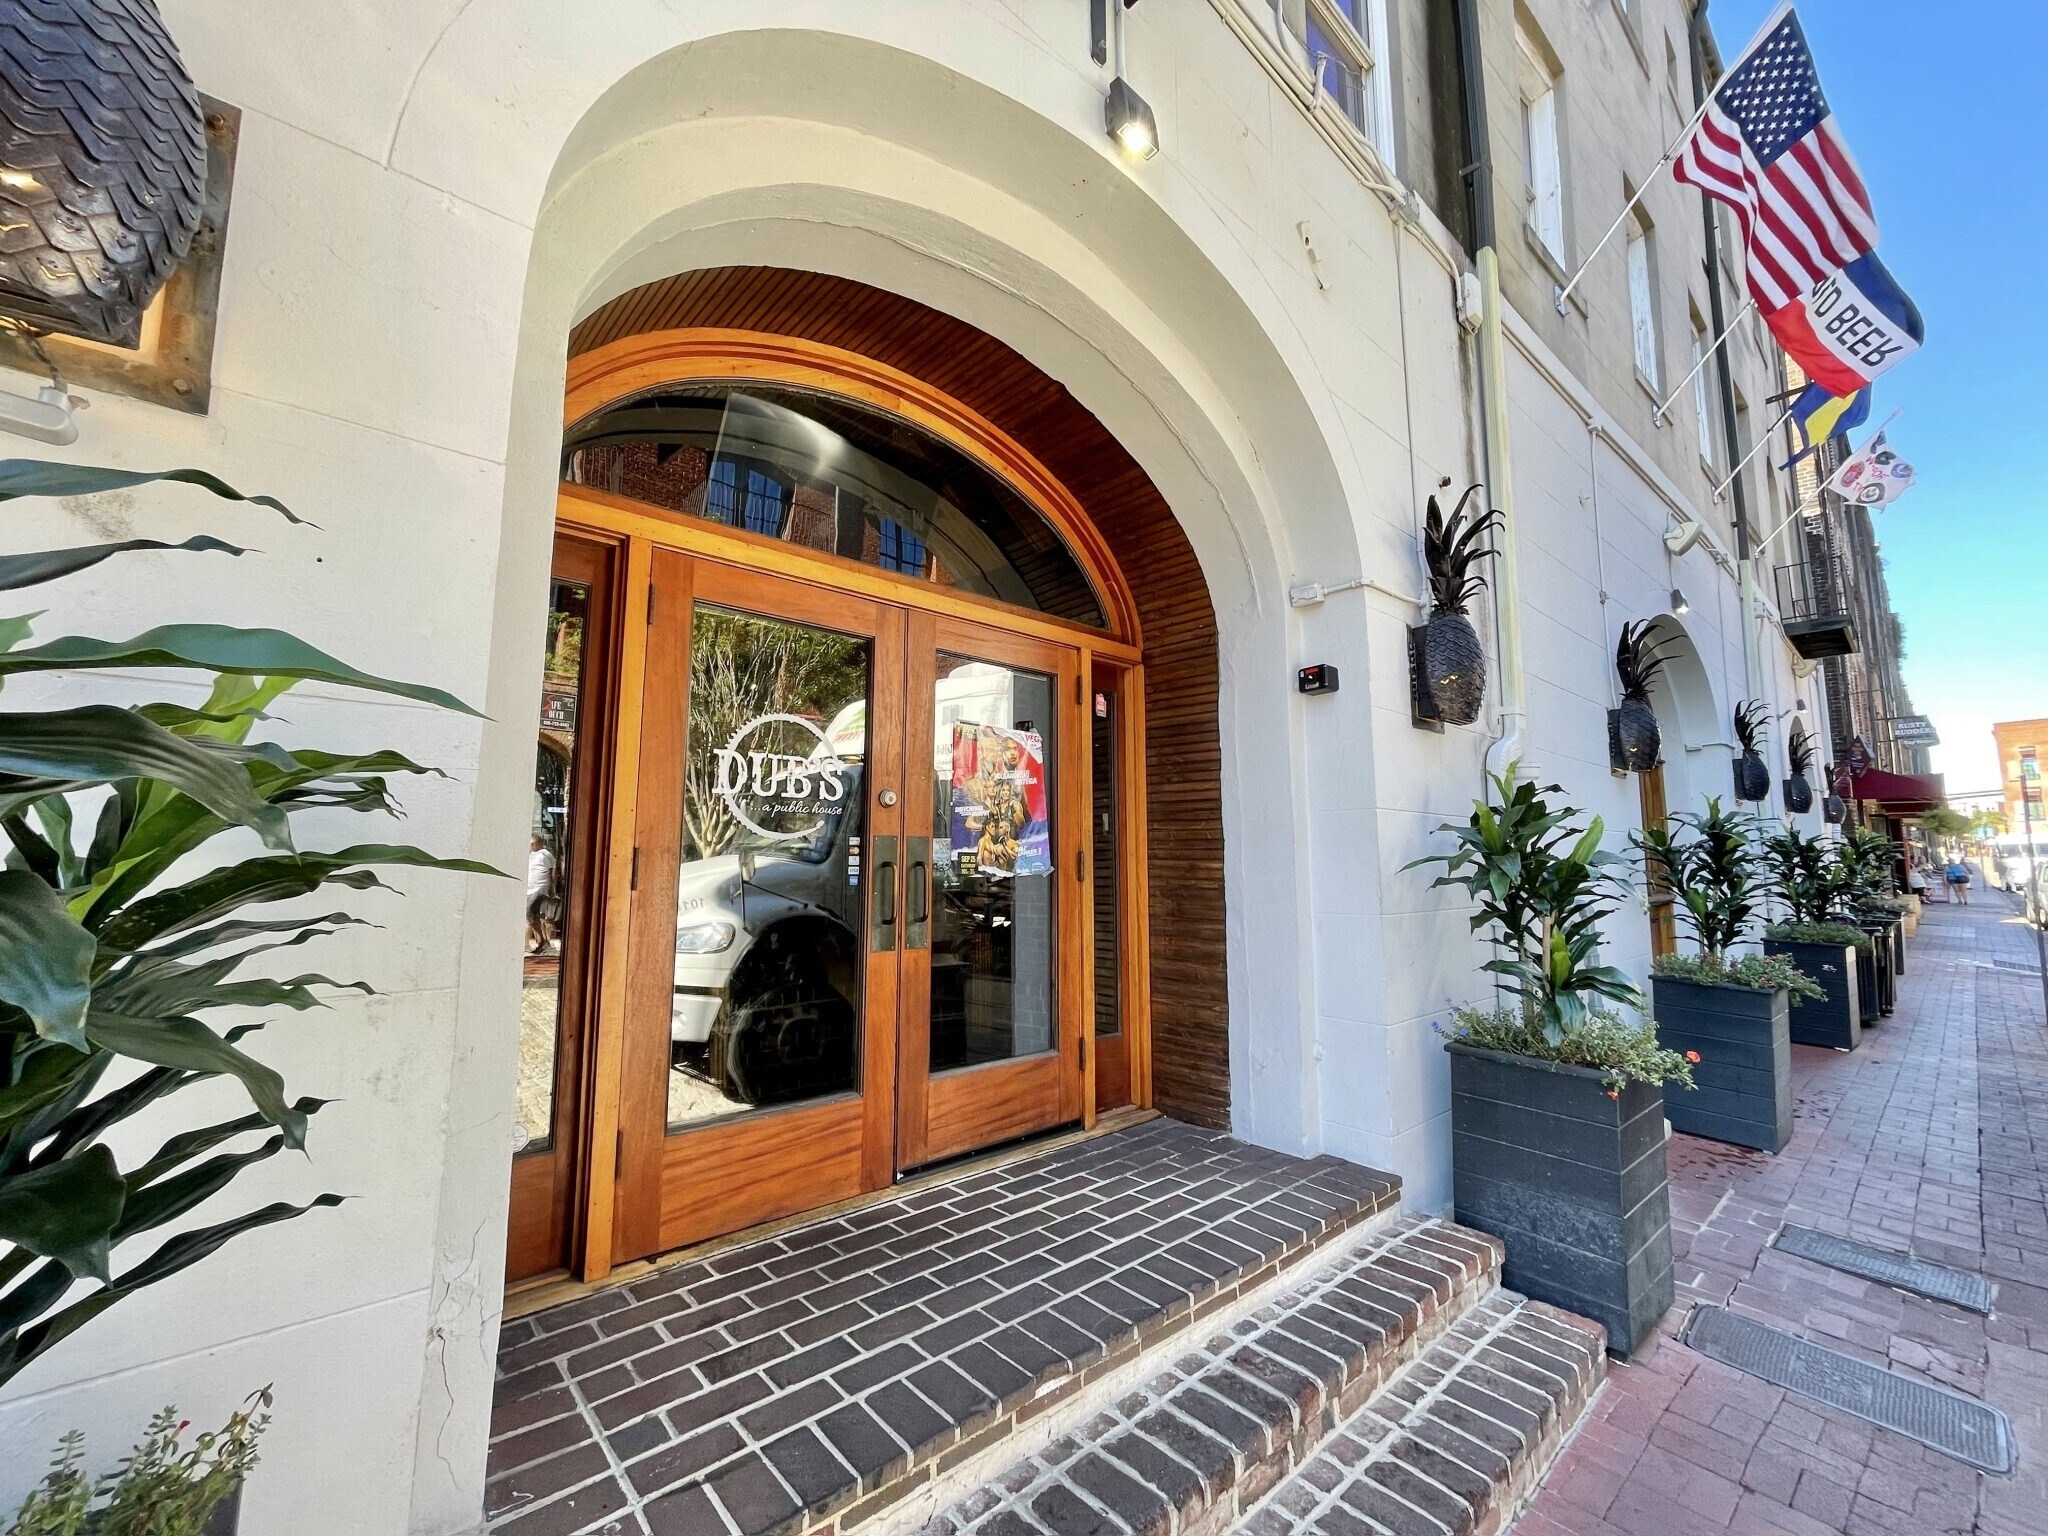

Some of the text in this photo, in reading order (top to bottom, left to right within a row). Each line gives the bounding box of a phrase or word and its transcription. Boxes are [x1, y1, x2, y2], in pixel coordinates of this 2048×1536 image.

[712, 748, 845, 801] DUB'S
[771, 801, 810, 818] public
[811, 802, 843, 816] house
